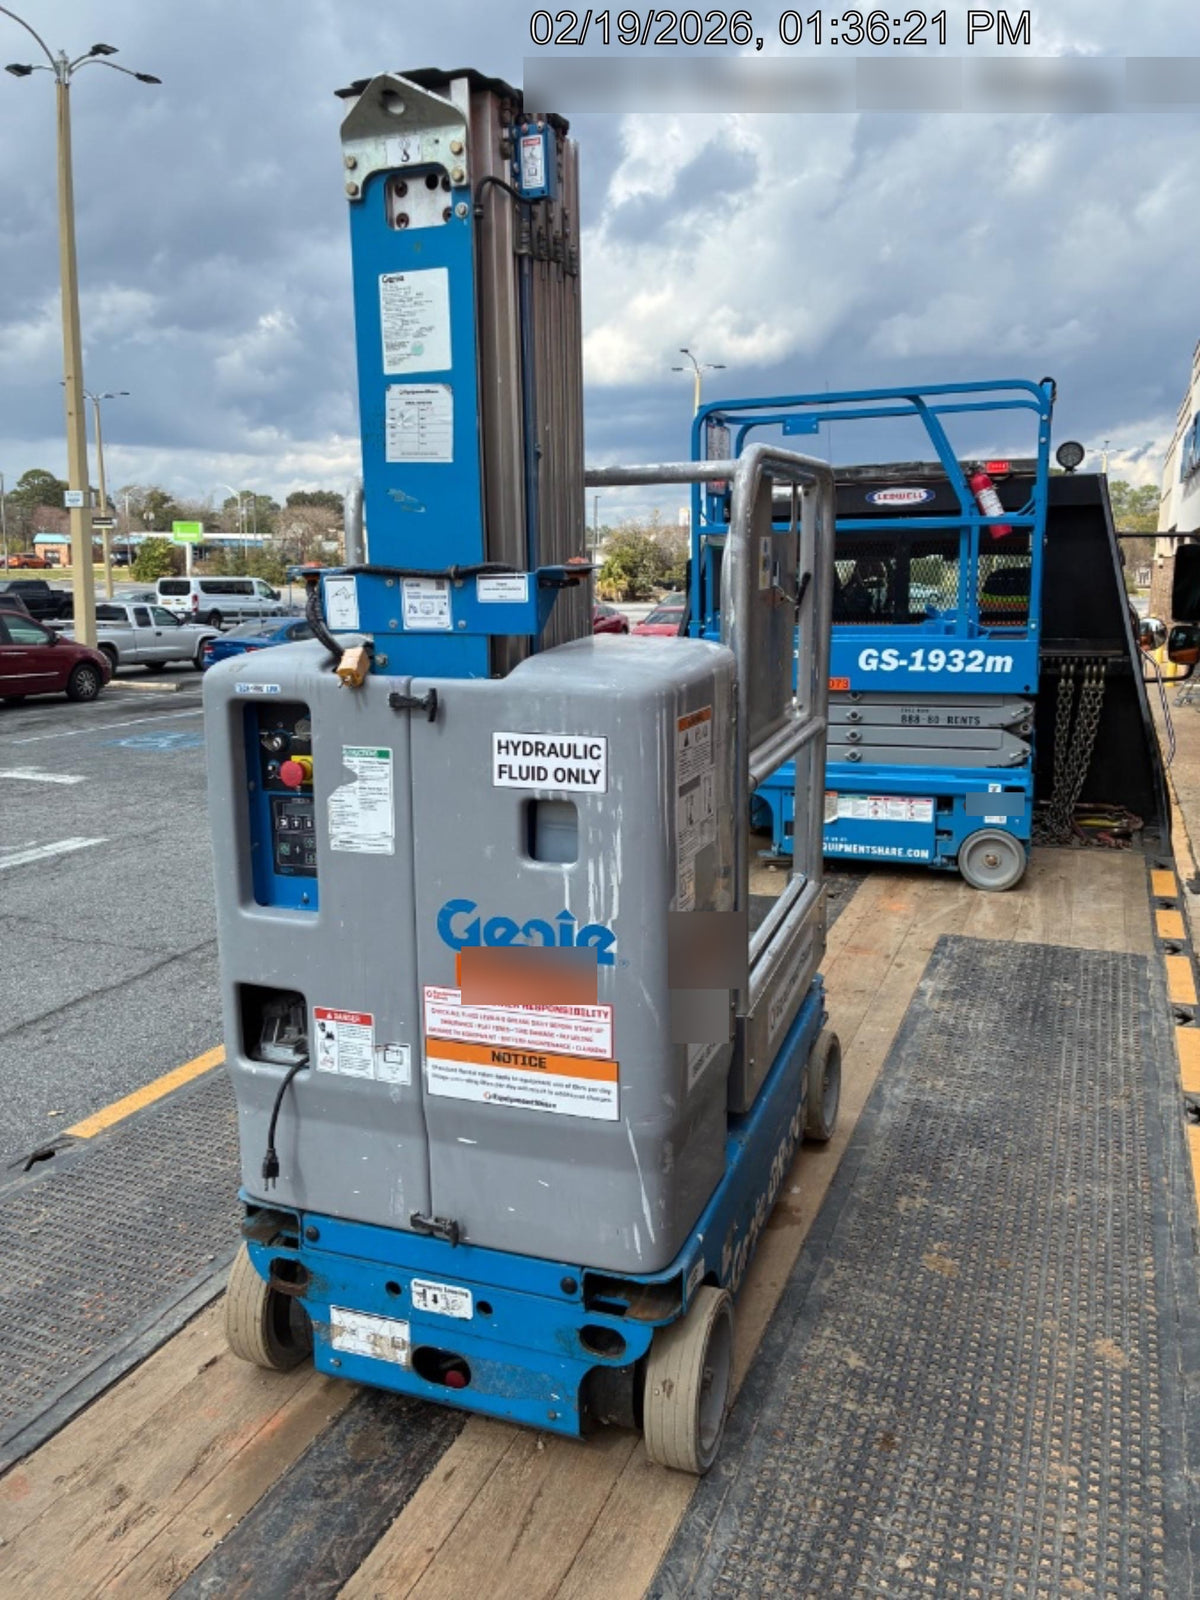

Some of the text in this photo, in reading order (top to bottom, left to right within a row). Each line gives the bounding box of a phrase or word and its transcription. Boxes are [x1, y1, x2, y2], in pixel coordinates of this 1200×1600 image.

[877, 492, 924, 501] LEDWELL
[858, 648, 1014, 673] GS-1932m
[497, 739, 602, 760] HYDRAULIC
[498, 764, 602, 785] FLUID ONLY
[437, 898, 618, 966] Genie
[333, 1012, 361, 1023] DANGER
[491, 1050, 548, 1069] NOTICE
